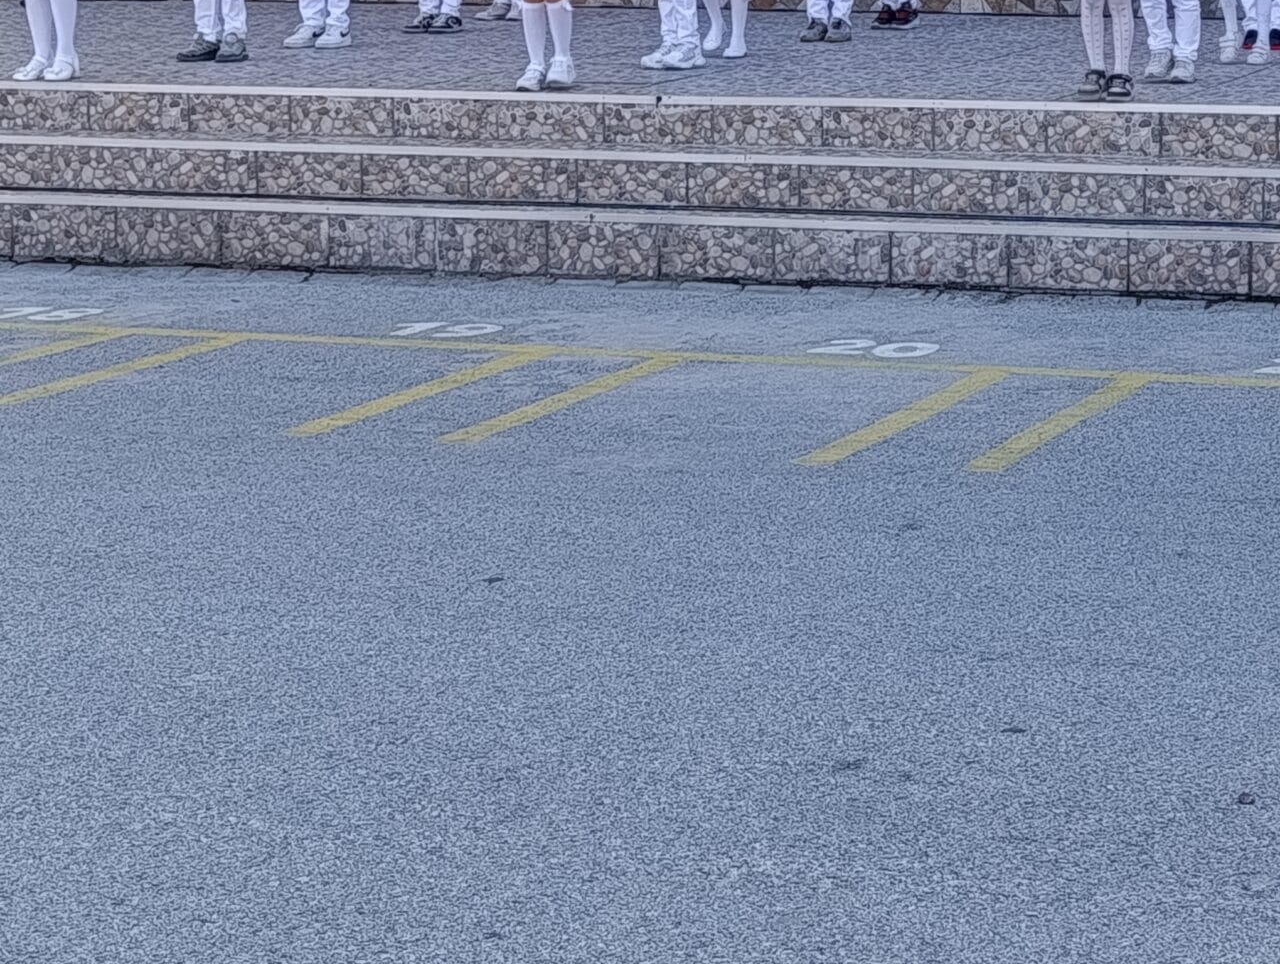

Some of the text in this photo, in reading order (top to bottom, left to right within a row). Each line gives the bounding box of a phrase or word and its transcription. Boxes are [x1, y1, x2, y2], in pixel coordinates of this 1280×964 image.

[0, 306, 104, 321] 18
[390, 322, 504, 337] 19
[806, 339, 940, 358] 20
